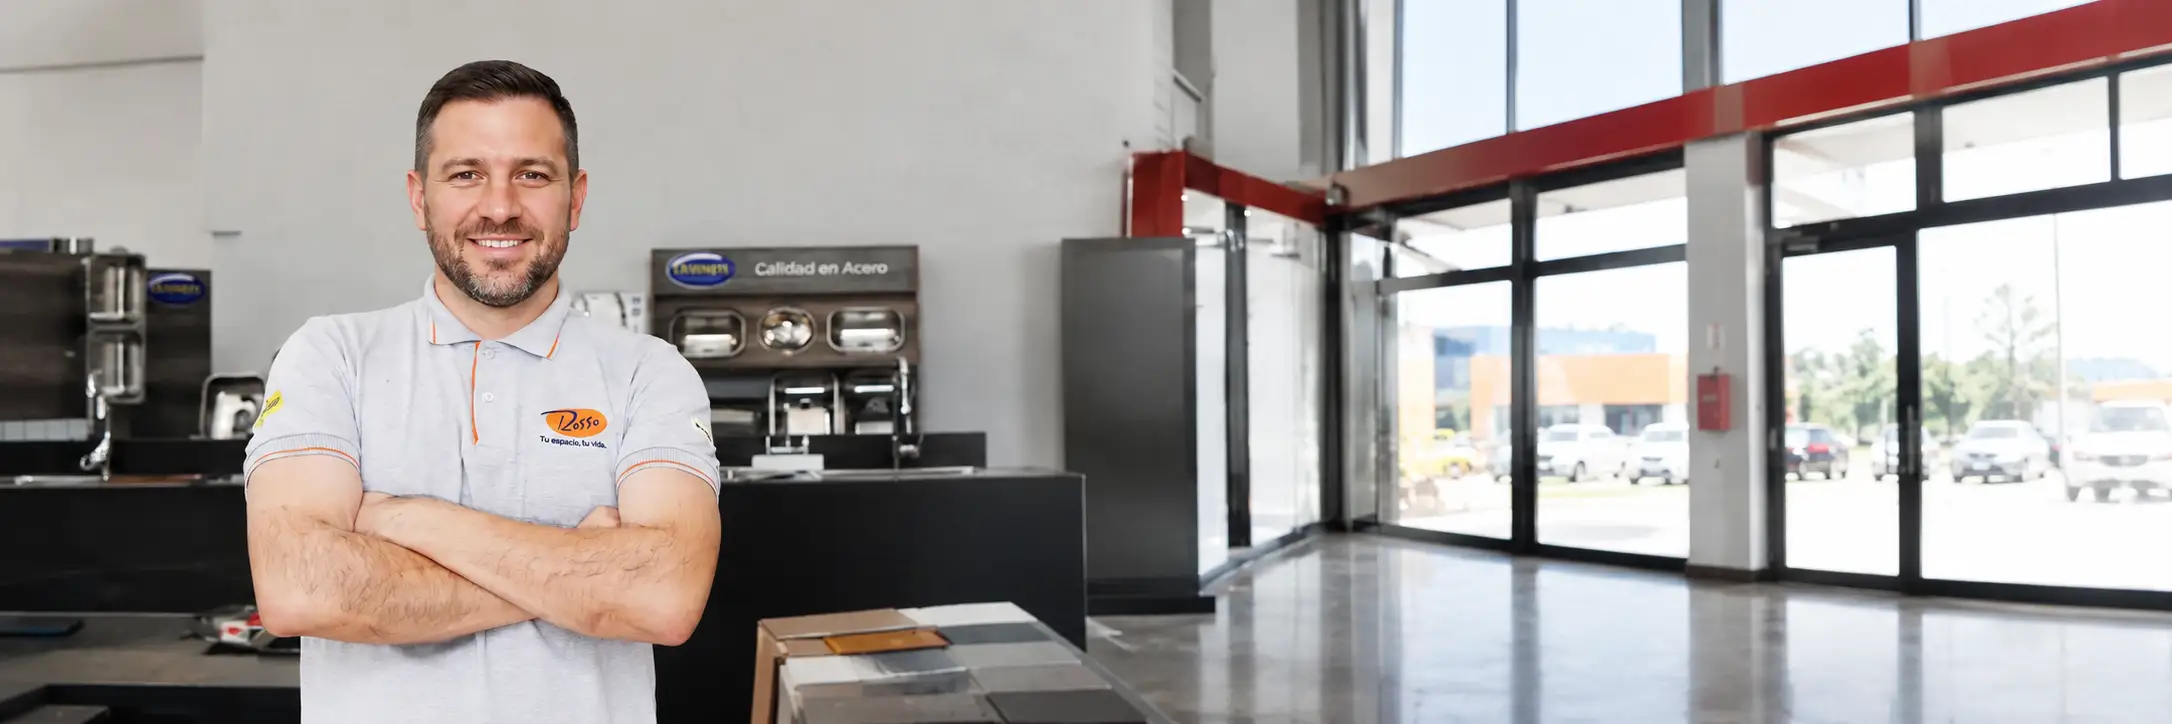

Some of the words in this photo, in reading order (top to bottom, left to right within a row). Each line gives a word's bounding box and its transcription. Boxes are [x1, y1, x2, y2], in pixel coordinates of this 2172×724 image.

[755, 261, 815, 276] Calidad
[818, 264, 839, 275] en
[841, 261, 888, 275] Acero
[541, 410, 599, 431] Rosso
[551, 438, 581, 447] espacio,
